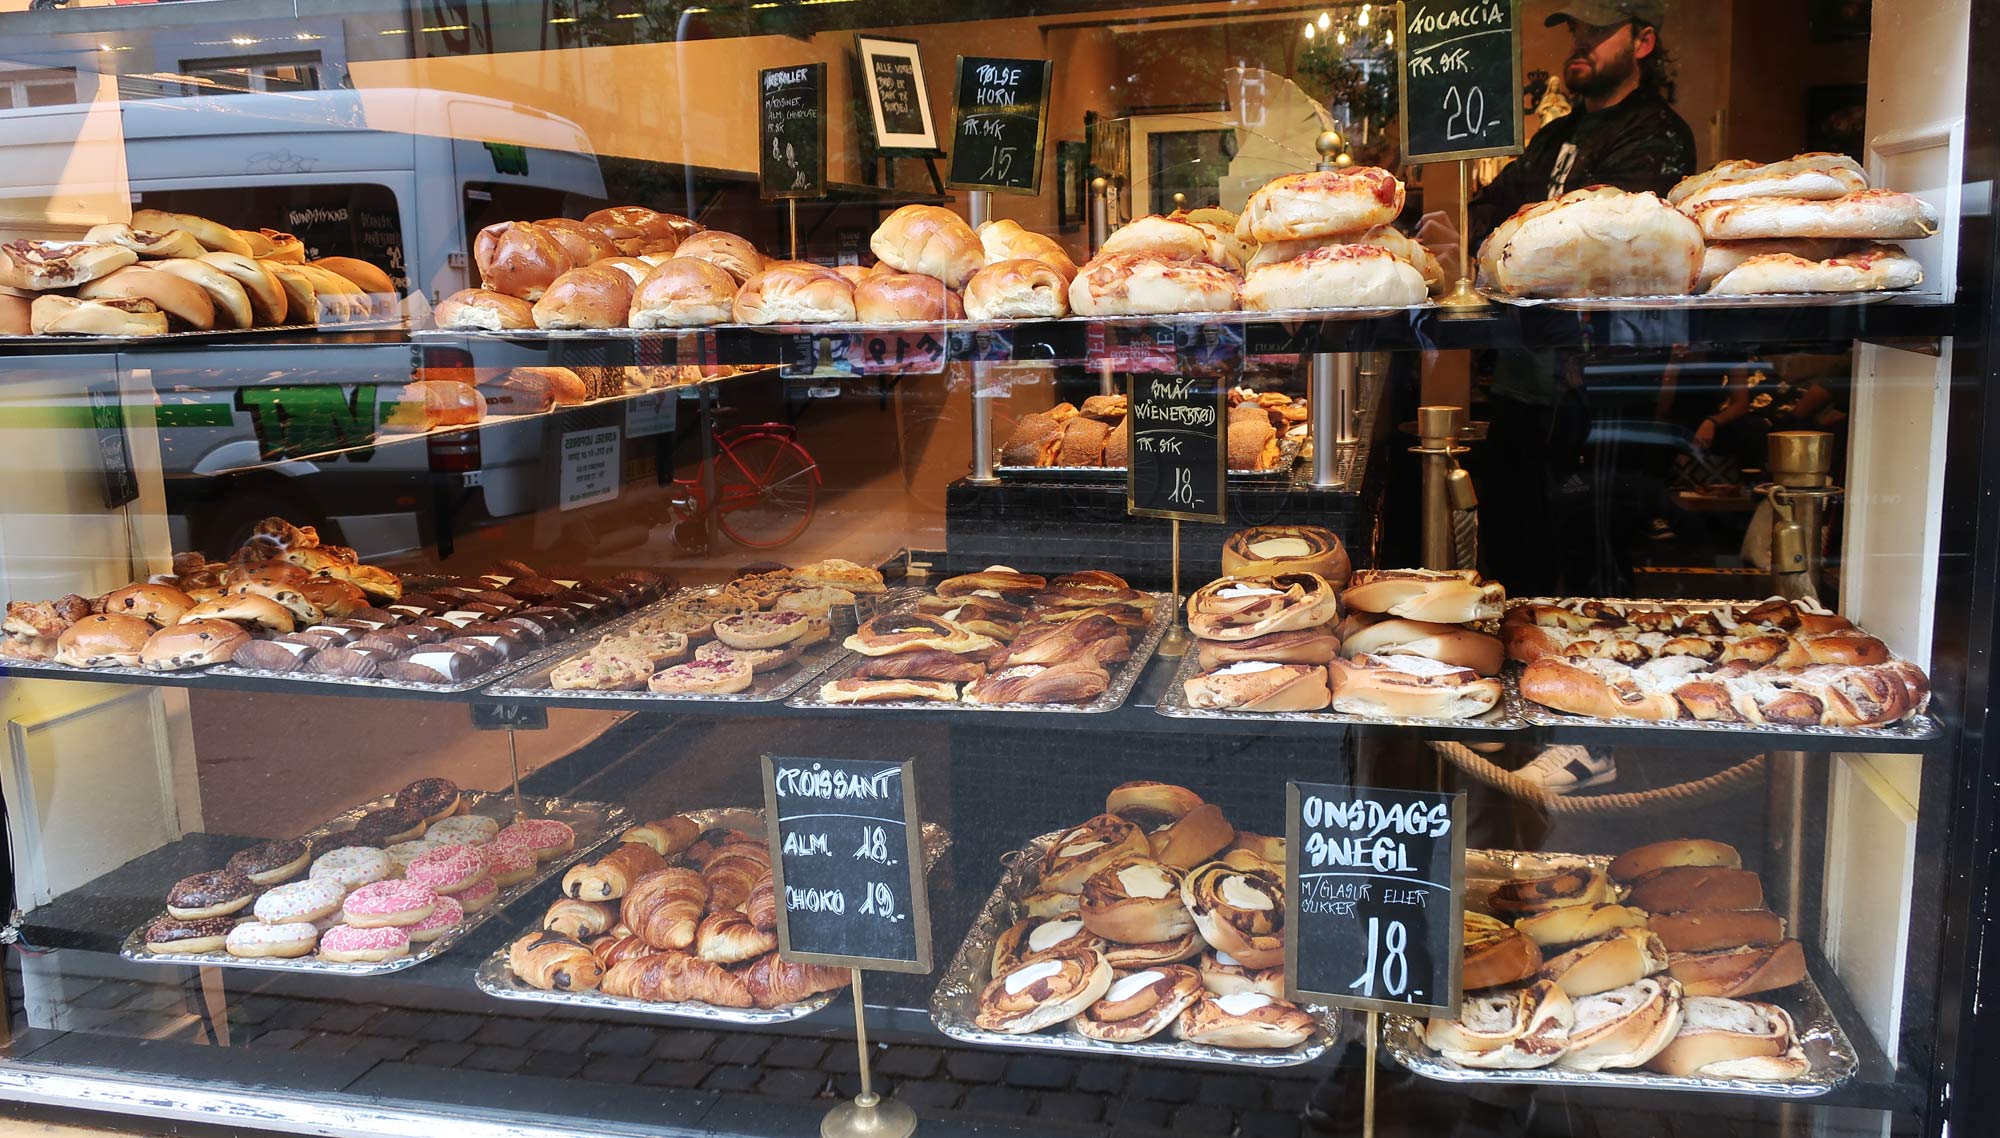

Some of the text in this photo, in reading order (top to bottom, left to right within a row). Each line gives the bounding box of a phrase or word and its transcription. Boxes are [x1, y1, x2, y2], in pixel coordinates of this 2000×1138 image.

[976, 64, 1022, 86] PØLSE
[976, 87, 1016, 107] HORN
[1159, 436, 1183, 455] STK
[775, 762, 902, 800] CROISSANT
[1303, 795, 1451, 838] ONSDAGS
[1304, 832, 1418, 873] SNEGL
[785, 885, 845, 915] CHOKO
[1301, 876, 1430, 908] M/GLASUR ELLER
[1301, 900, 1356, 919] SUKKER
